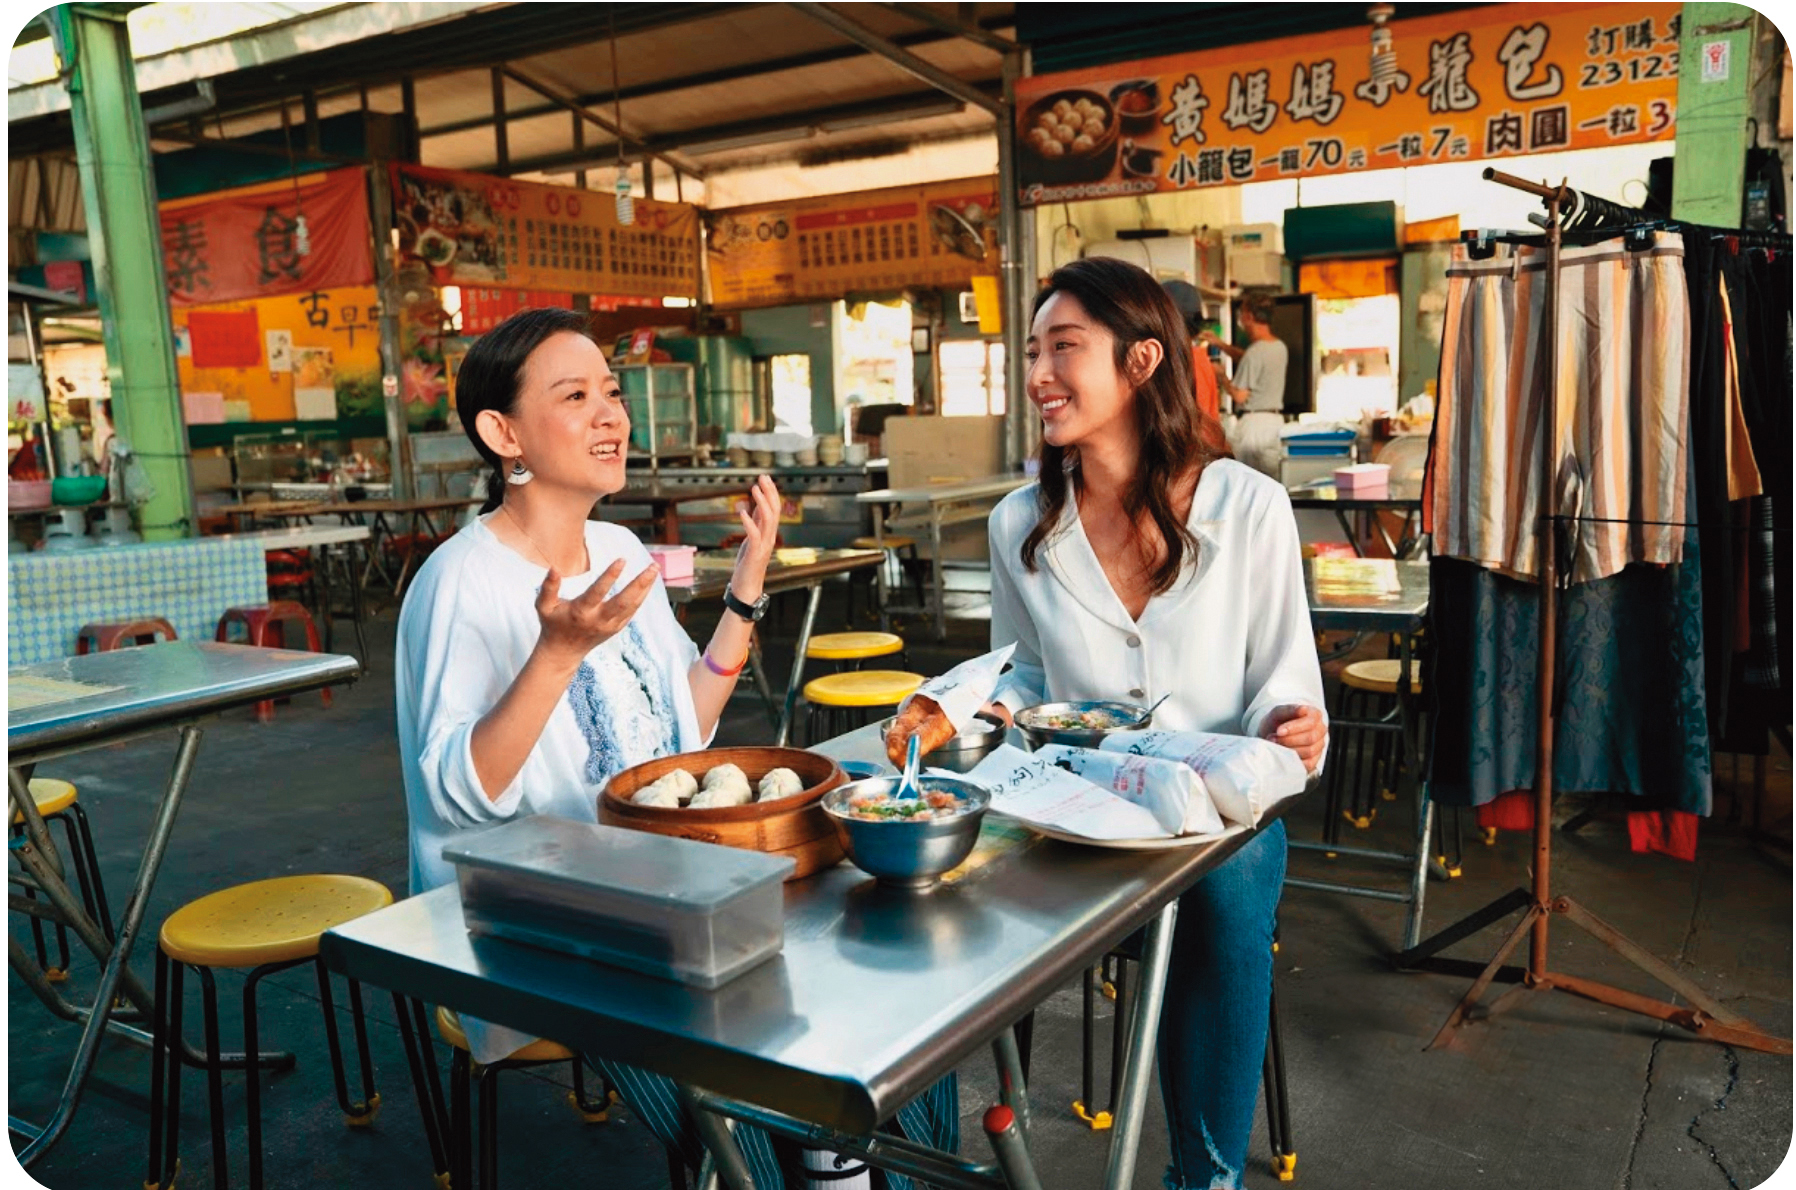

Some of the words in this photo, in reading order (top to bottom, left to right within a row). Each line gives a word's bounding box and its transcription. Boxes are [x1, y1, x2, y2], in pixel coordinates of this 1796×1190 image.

[1167, 149, 1255, 187] 小籠包
[1485, 105, 1568, 155] 肉圓
[162, 205, 305, 293] 素食
